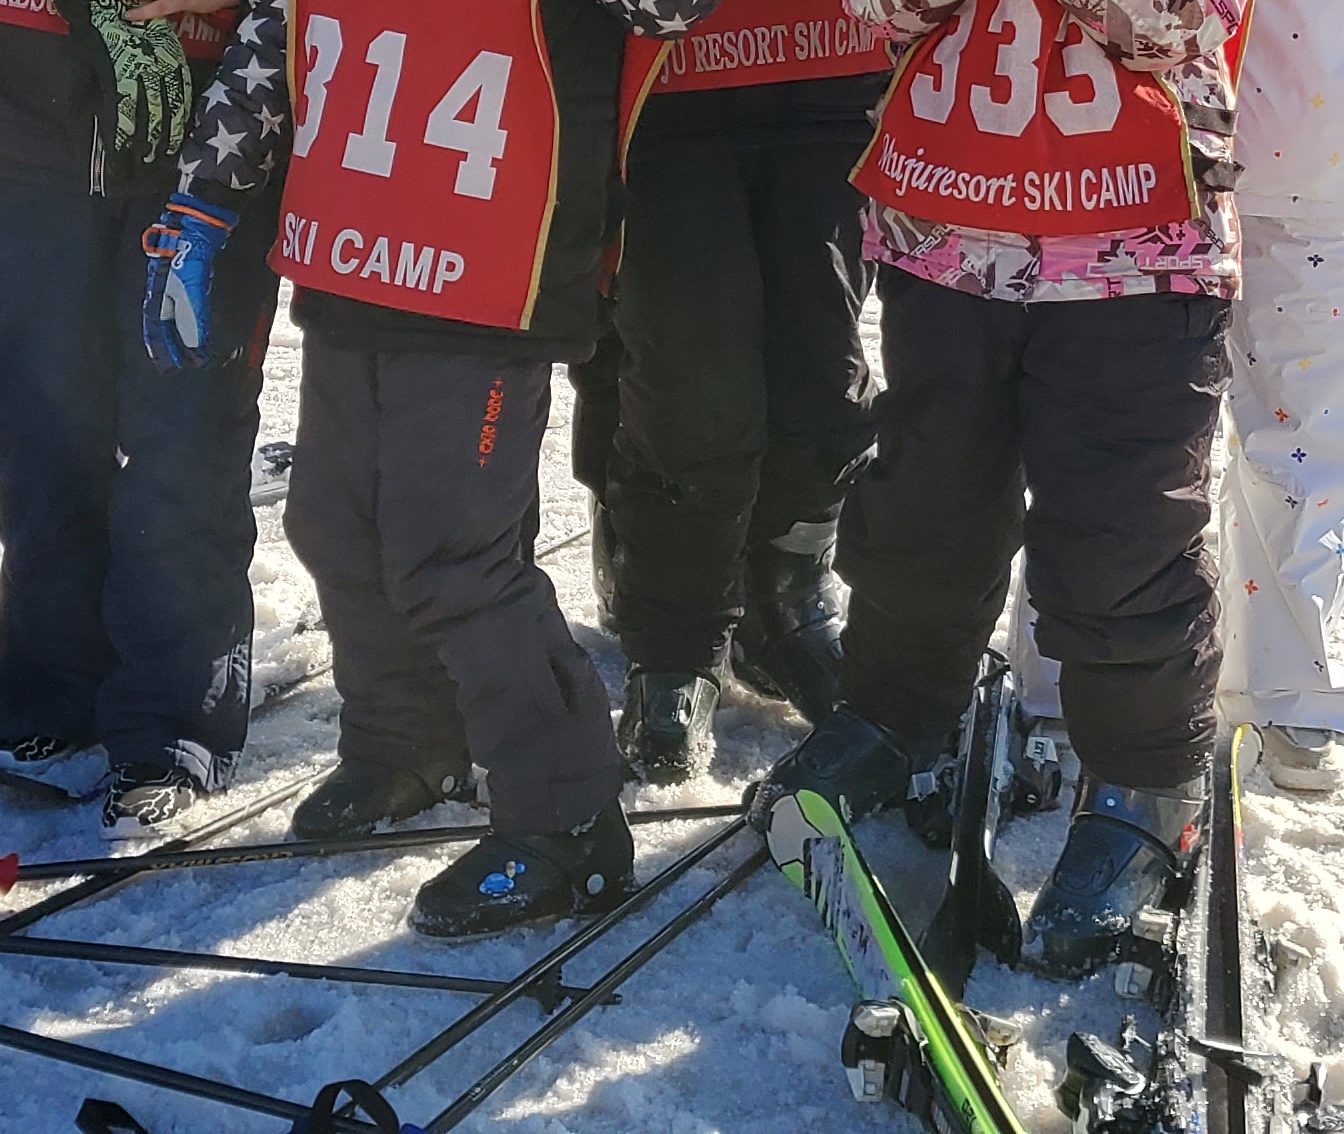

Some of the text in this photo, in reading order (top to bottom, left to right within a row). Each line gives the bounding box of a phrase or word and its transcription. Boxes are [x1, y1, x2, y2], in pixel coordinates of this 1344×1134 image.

[694, 28, 787, 74] RESORT
[795, 21, 831, 60] SKI
[292, 14, 514, 200] 314
[878, 133, 1156, 212] Mujuresort SKI CAMP
[282, 212, 465, 294] SKI CAMP
